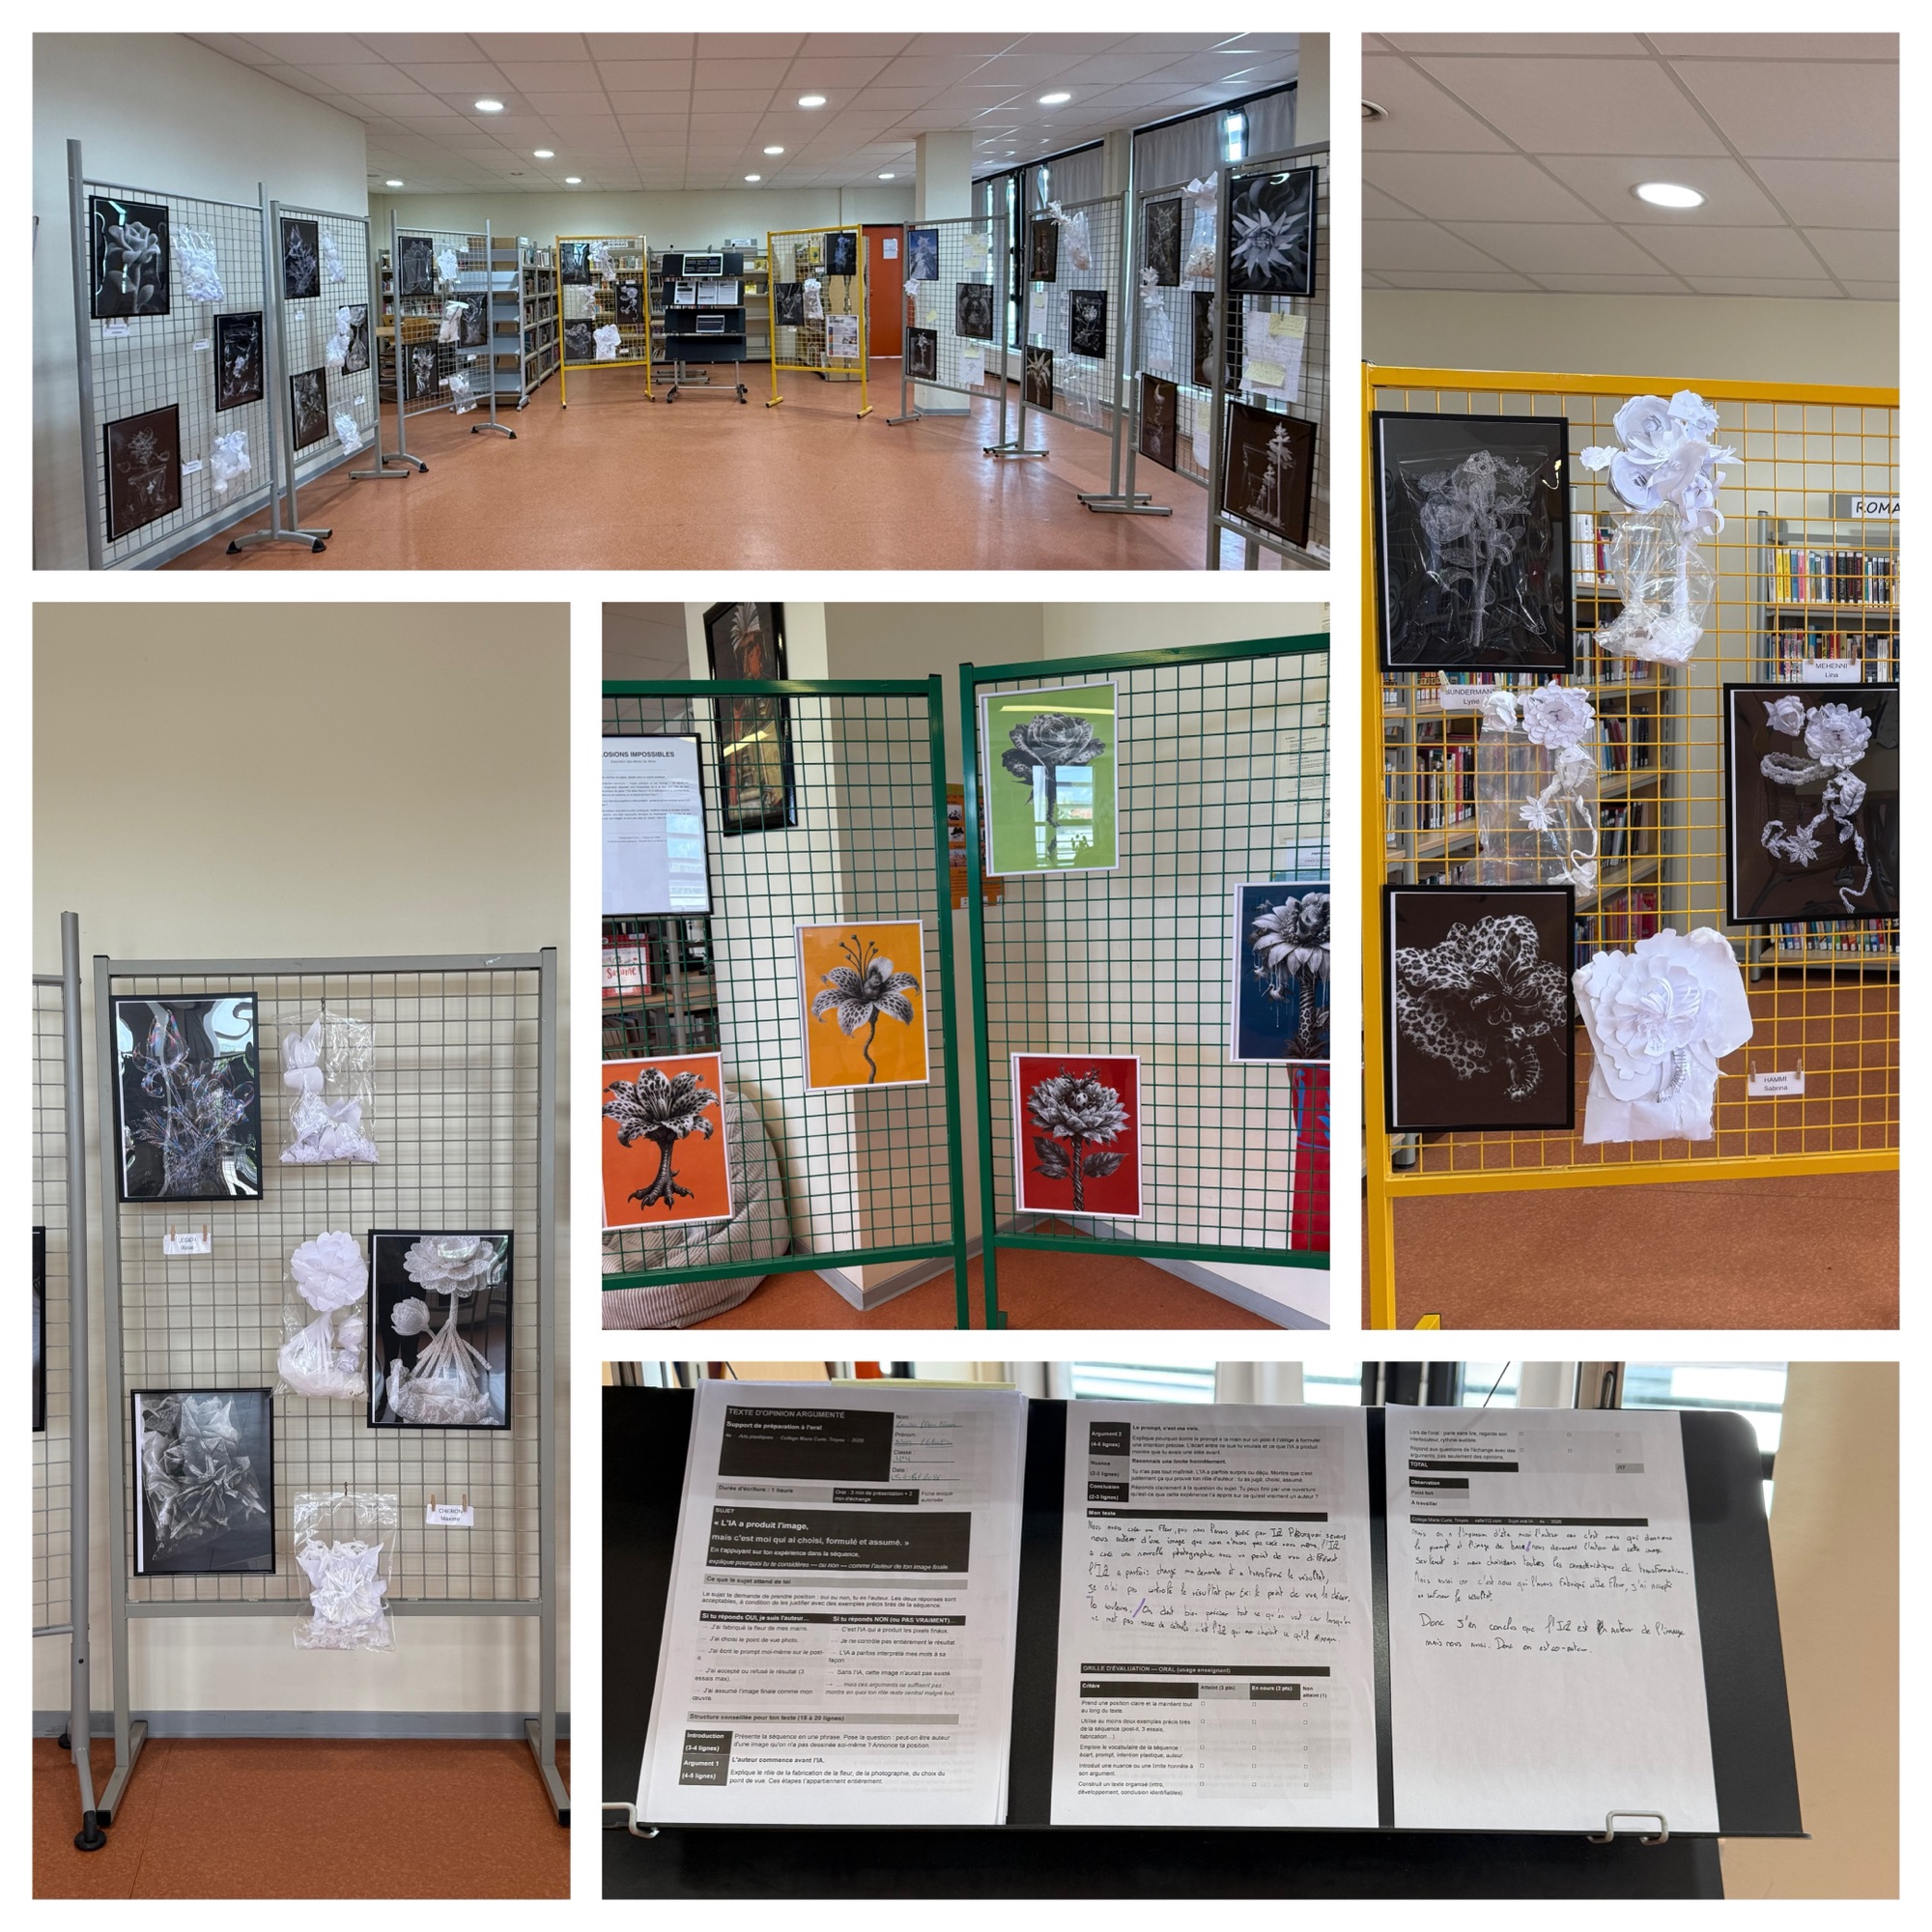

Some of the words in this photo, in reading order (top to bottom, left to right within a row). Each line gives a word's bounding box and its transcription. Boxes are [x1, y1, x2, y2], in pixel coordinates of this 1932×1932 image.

[796, 1409, 845, 1418] ARGUMENTÉ
[762, 1422, 800, 1431] préparation
[745, 1520, 776, 1530] produit
[777, 1521, 810, 1531] l'image,
[772, 1535, 785, 1544] qui
[796, 1536, 824, 1545] choisi,
[825, 1536, 857, 1545] formulé
[867, 1537, 902, 1546] assumé.
